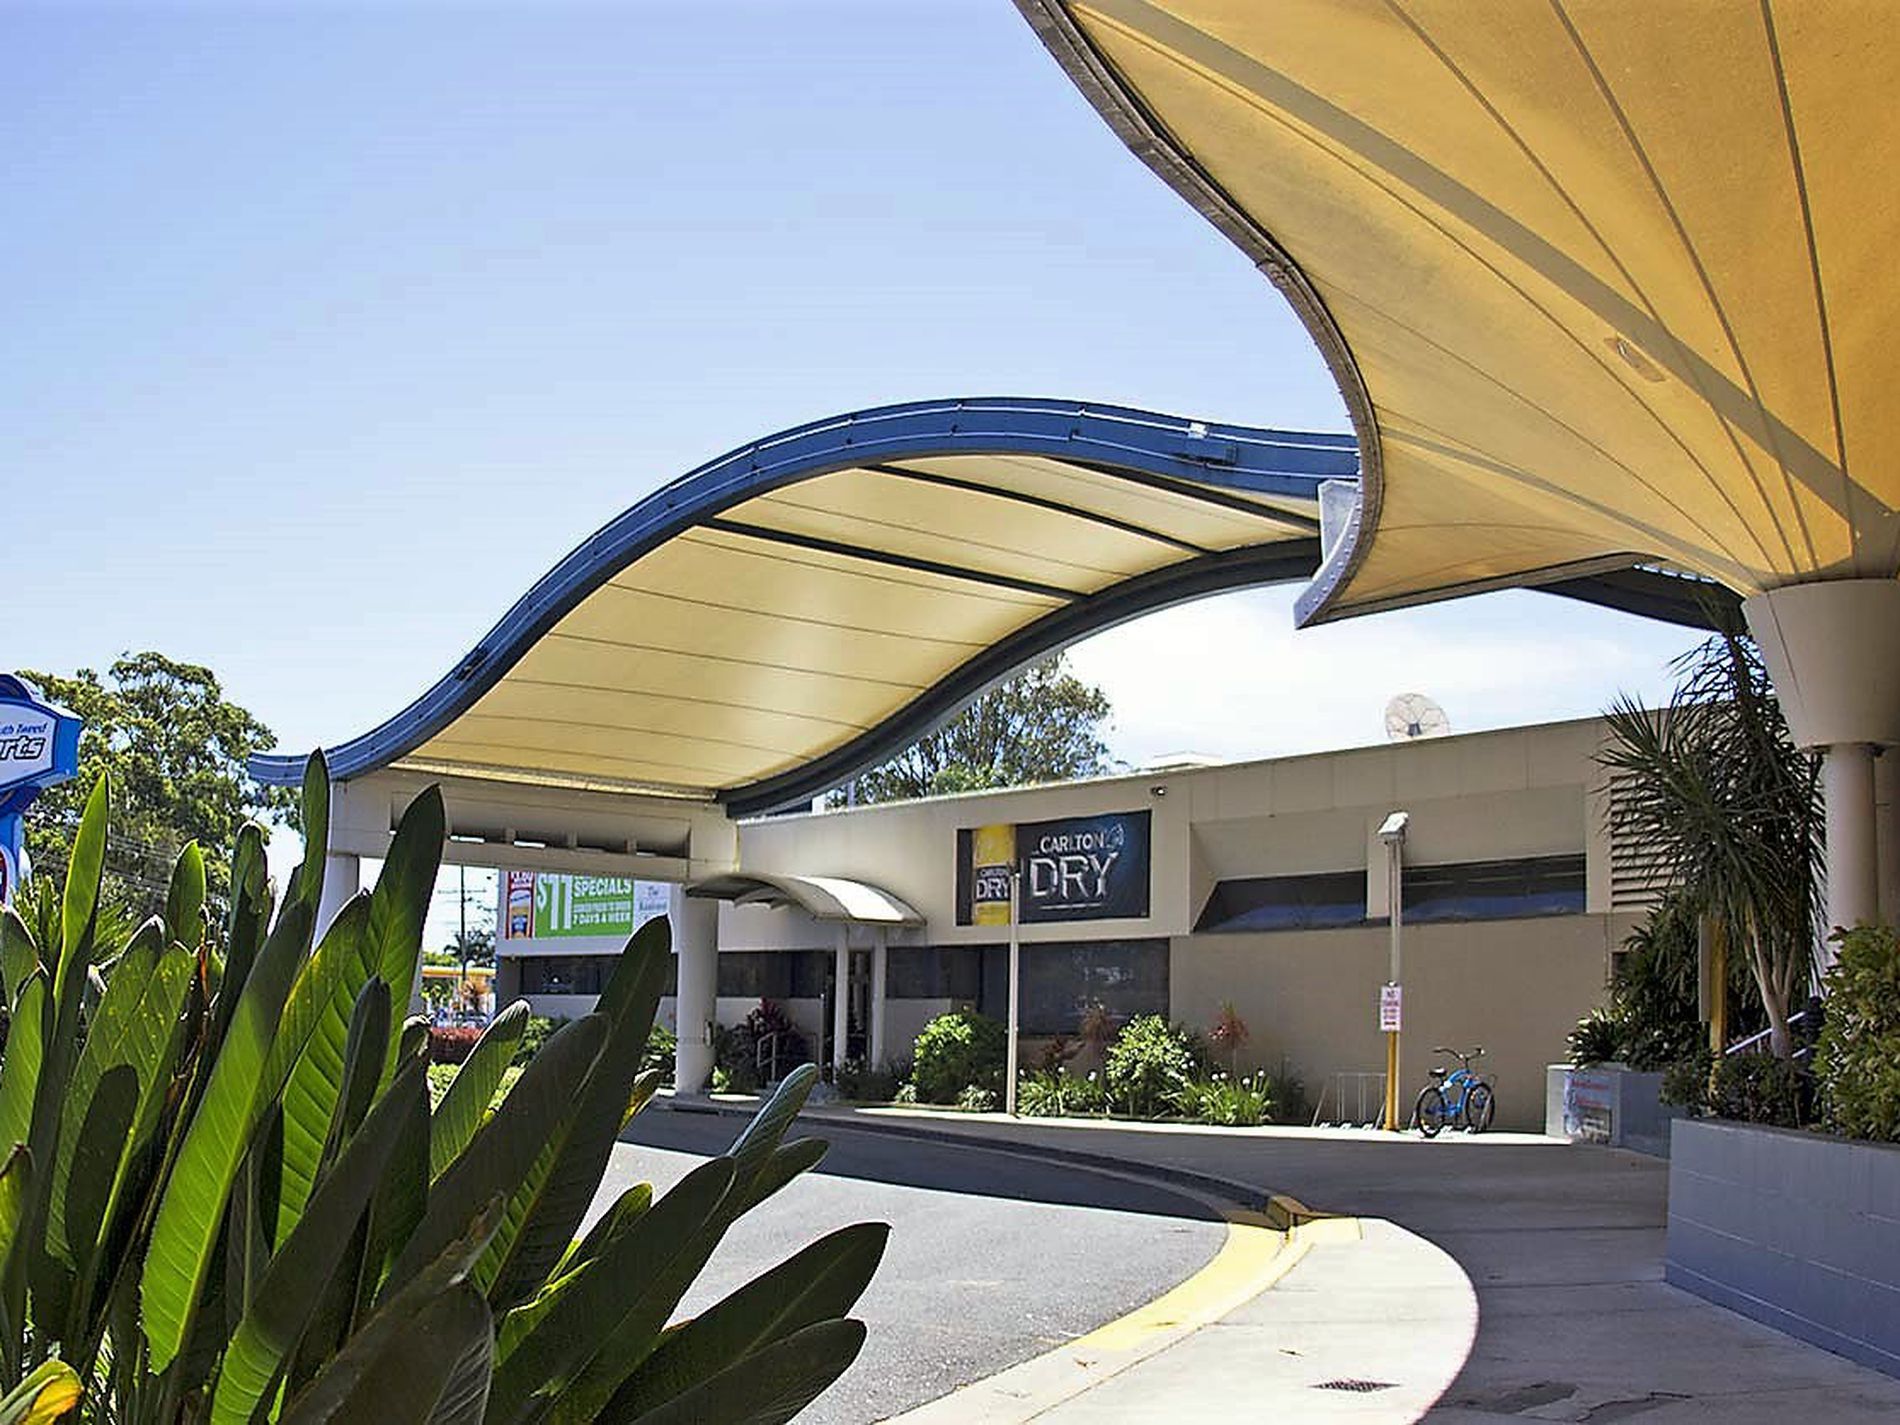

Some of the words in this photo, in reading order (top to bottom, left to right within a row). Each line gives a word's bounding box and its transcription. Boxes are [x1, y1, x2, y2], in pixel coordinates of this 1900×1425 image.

[1040, 833, 1104, 852] CARLTON
[1030, 851, 1119, 899] DRY
[574, 877, 631, 897] SPECIALS
[975, 876, 1009, 899] DRY
